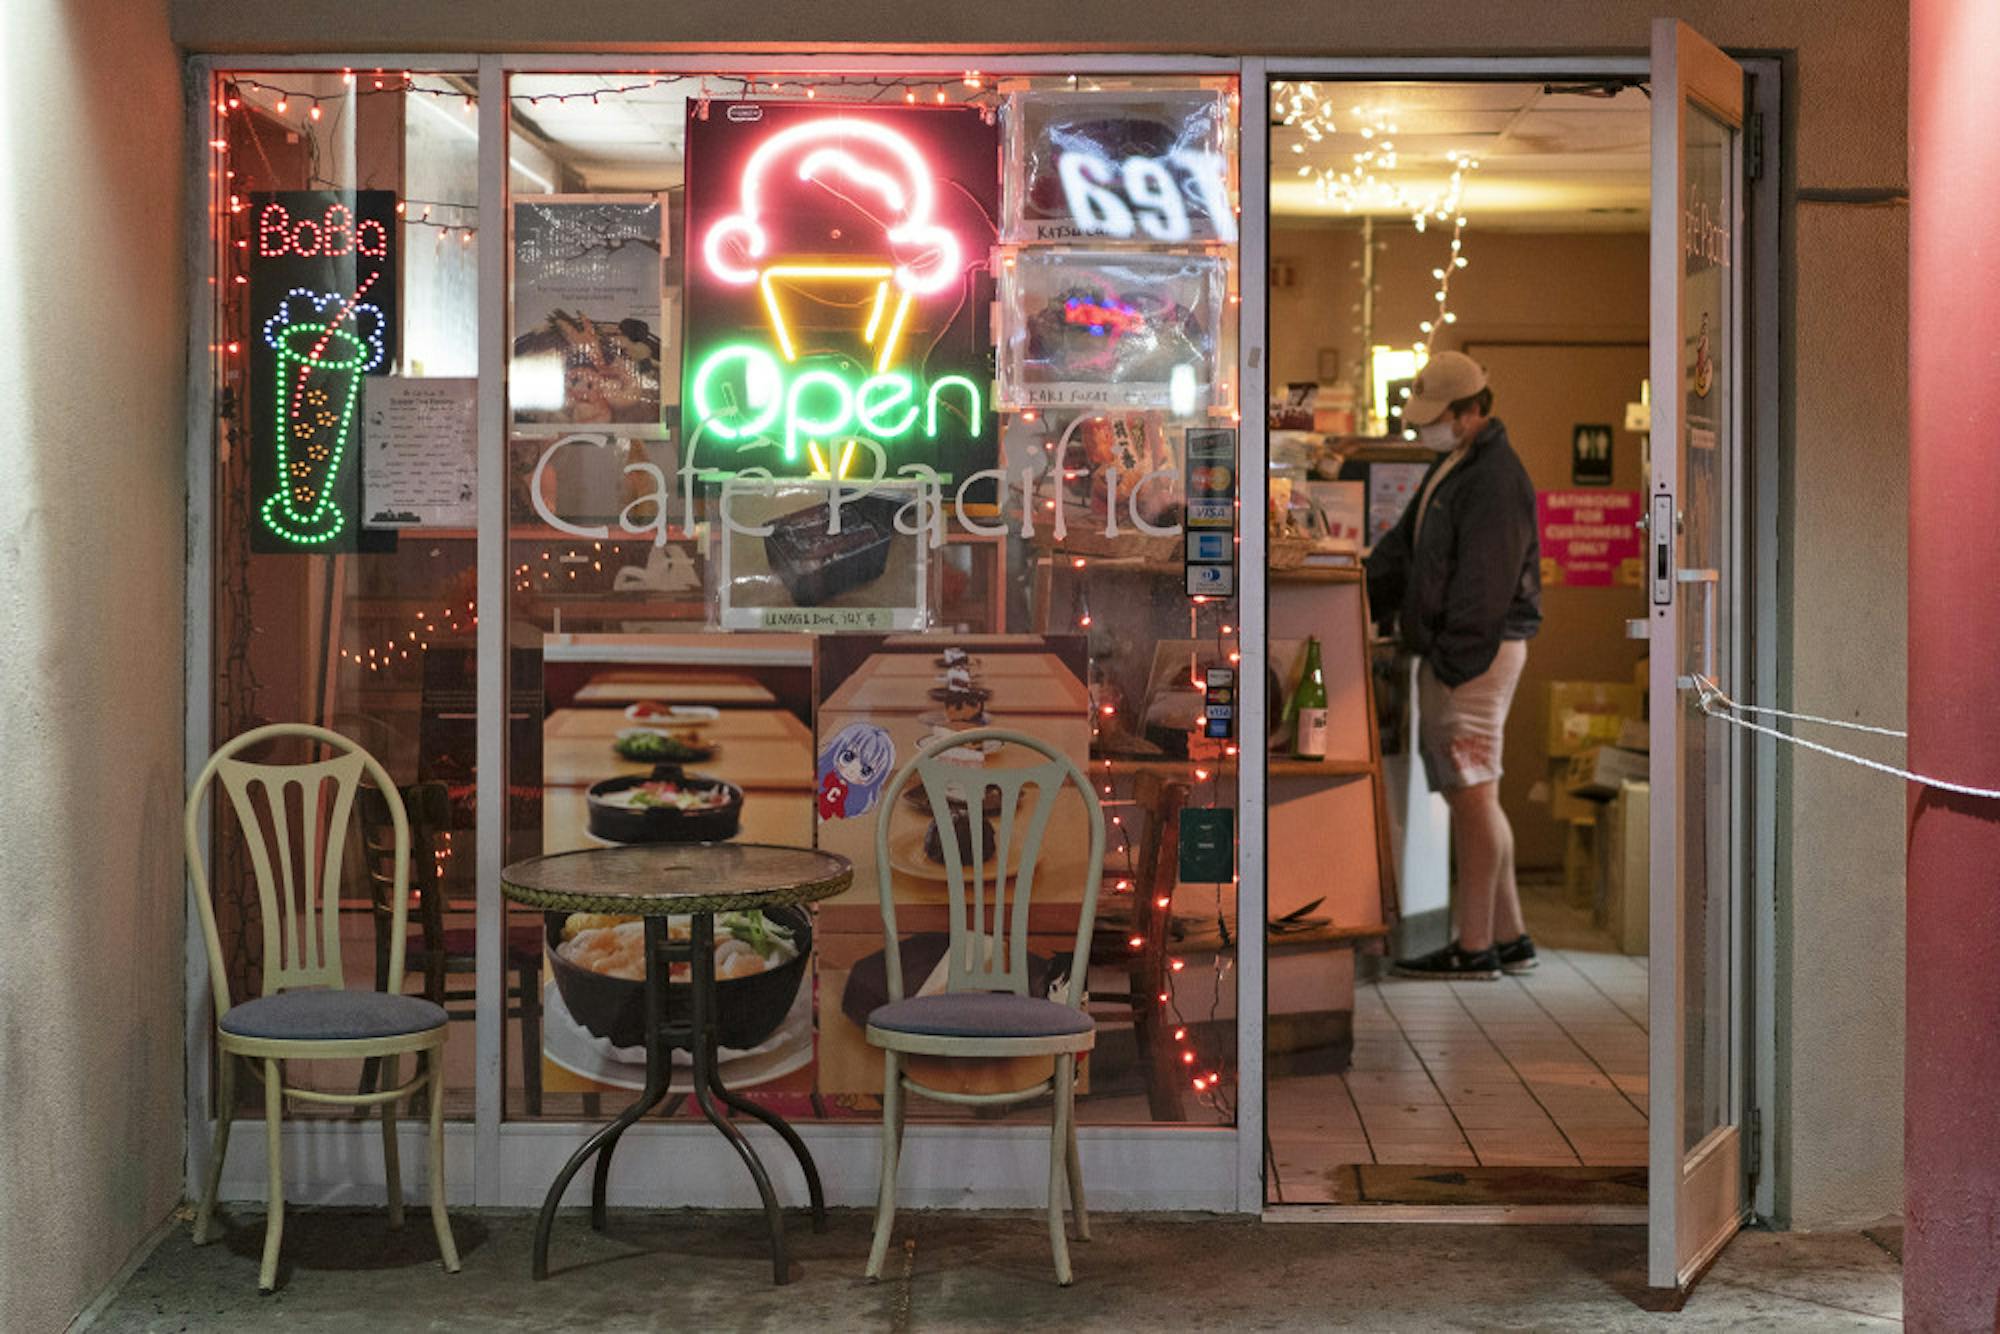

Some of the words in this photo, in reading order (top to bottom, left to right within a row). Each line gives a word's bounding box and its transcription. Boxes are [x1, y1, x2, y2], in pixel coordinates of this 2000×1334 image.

[692, 344, 982, 462] Open
[531, 406, 776, 548] Café
[827, 410, 1183, 549] Pacific
[1196, 507, 1226, 518] VISA
[826, 786, 842, 803] C
